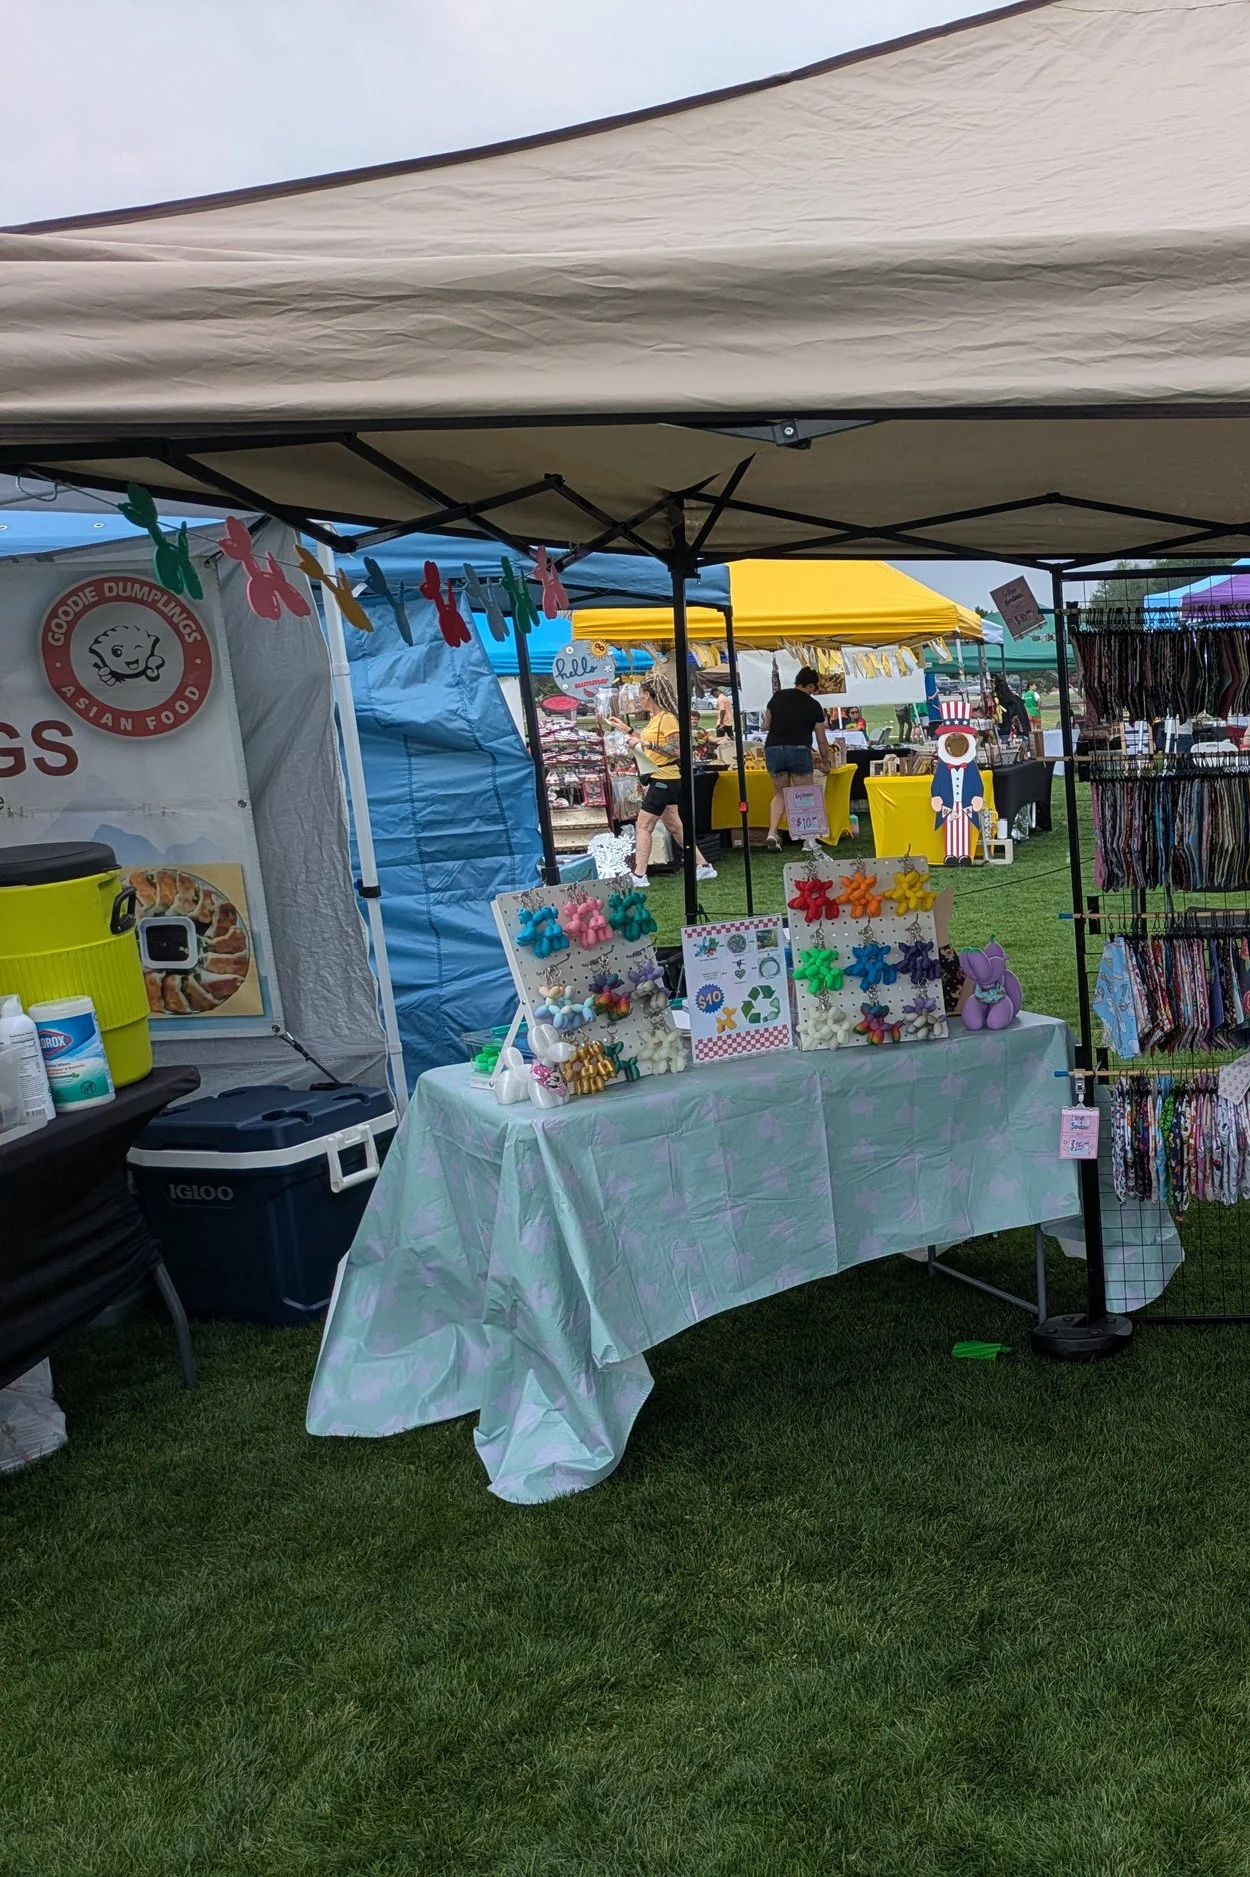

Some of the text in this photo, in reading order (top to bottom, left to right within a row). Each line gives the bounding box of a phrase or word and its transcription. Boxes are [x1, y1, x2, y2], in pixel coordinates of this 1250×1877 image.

[48, 582, 201, 646] GOODIE DUMPLINGS
[555, 656, 597, 680] hello
[61, 685, 200, 731] ASIAN FOOD
[697, 989, 722, 1010] $10
[168, 1184, 234, 1201] IGLOO
